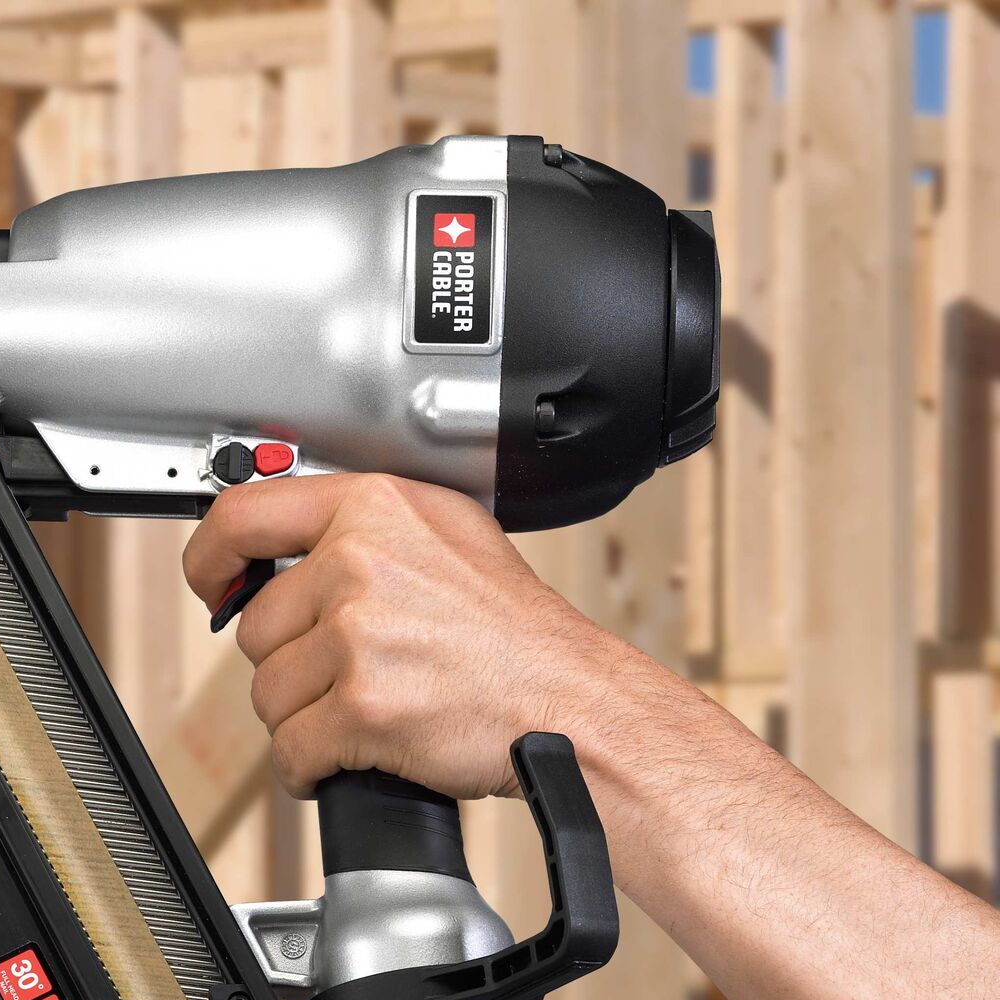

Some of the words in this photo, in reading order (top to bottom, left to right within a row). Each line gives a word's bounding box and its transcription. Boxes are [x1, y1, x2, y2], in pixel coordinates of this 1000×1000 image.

[453, 251, 475, 332] PORTER
[0, 970, 9, 986] FULL
[8, 985, 19, 1000] HEAD
[0, 981, 9, 995] NAIL
